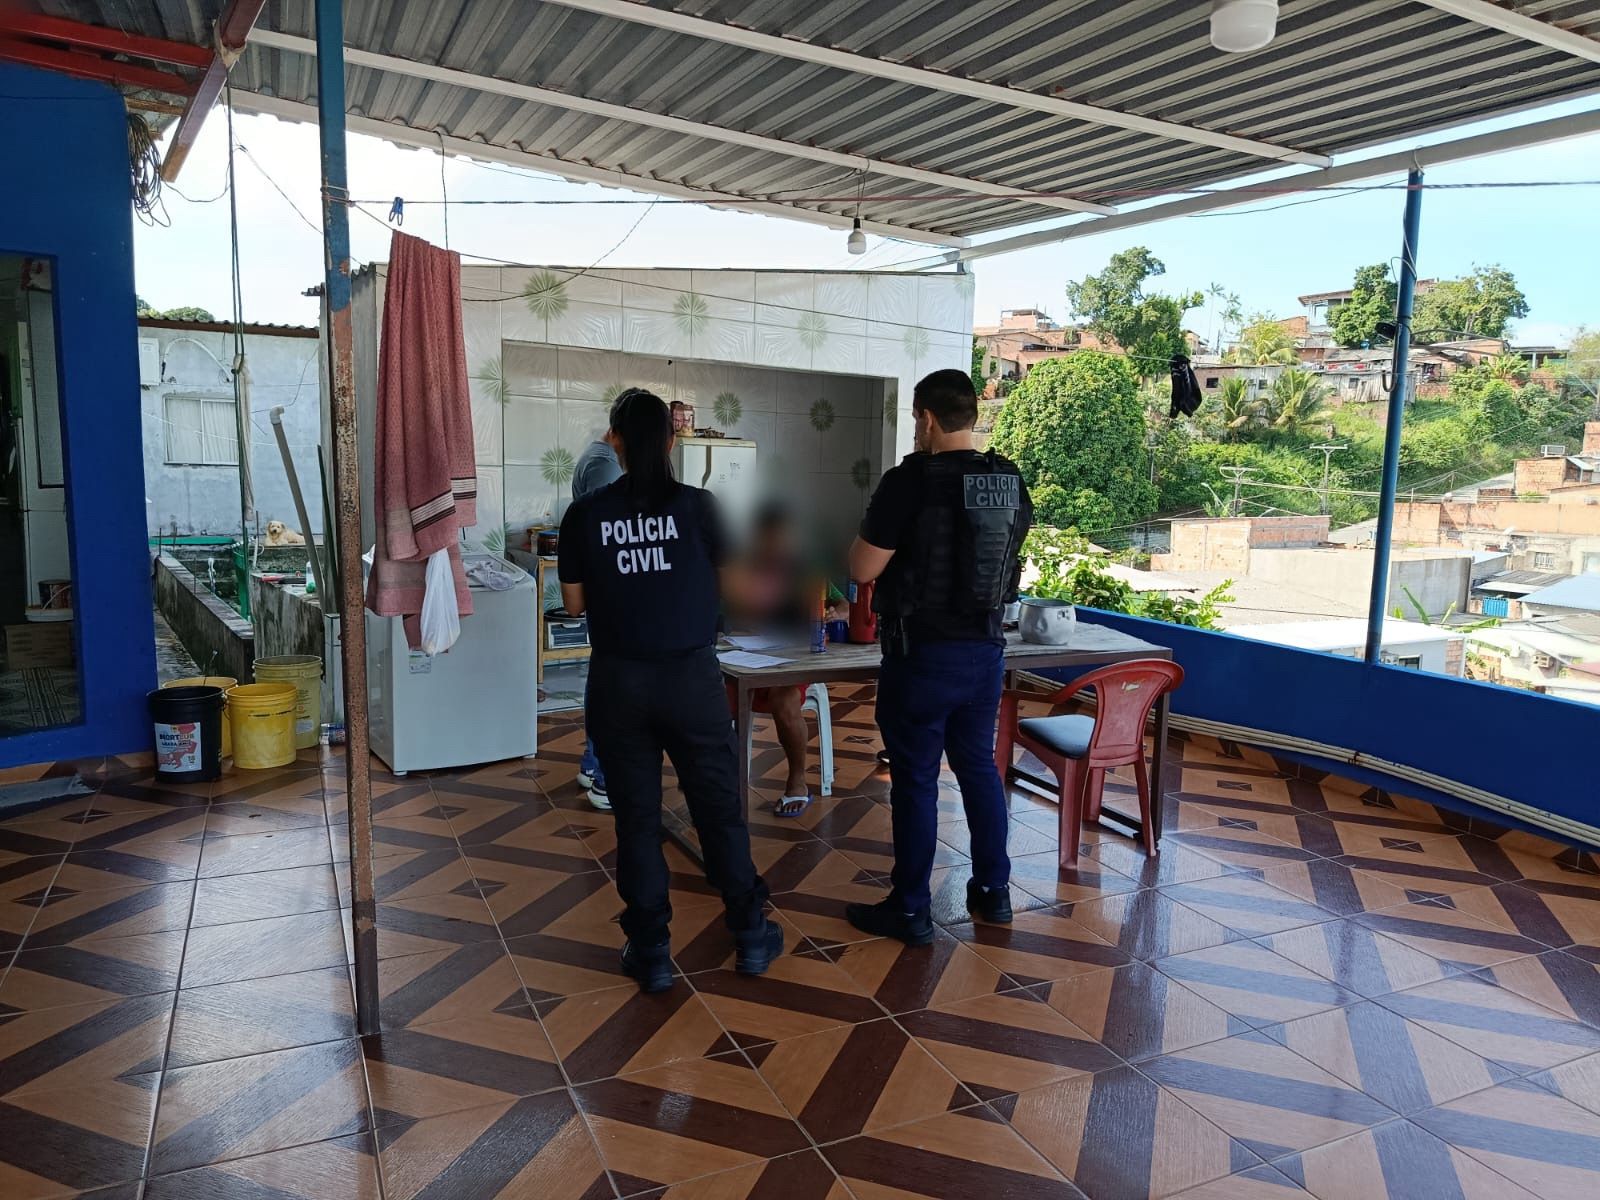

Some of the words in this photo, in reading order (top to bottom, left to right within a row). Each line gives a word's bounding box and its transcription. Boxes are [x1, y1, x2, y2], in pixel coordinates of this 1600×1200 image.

[976, 493, 1014, 507] CIVIL
[600, 512, 679, 546] POLÍCIA
[617, 546, 672, 575] CIVIL
